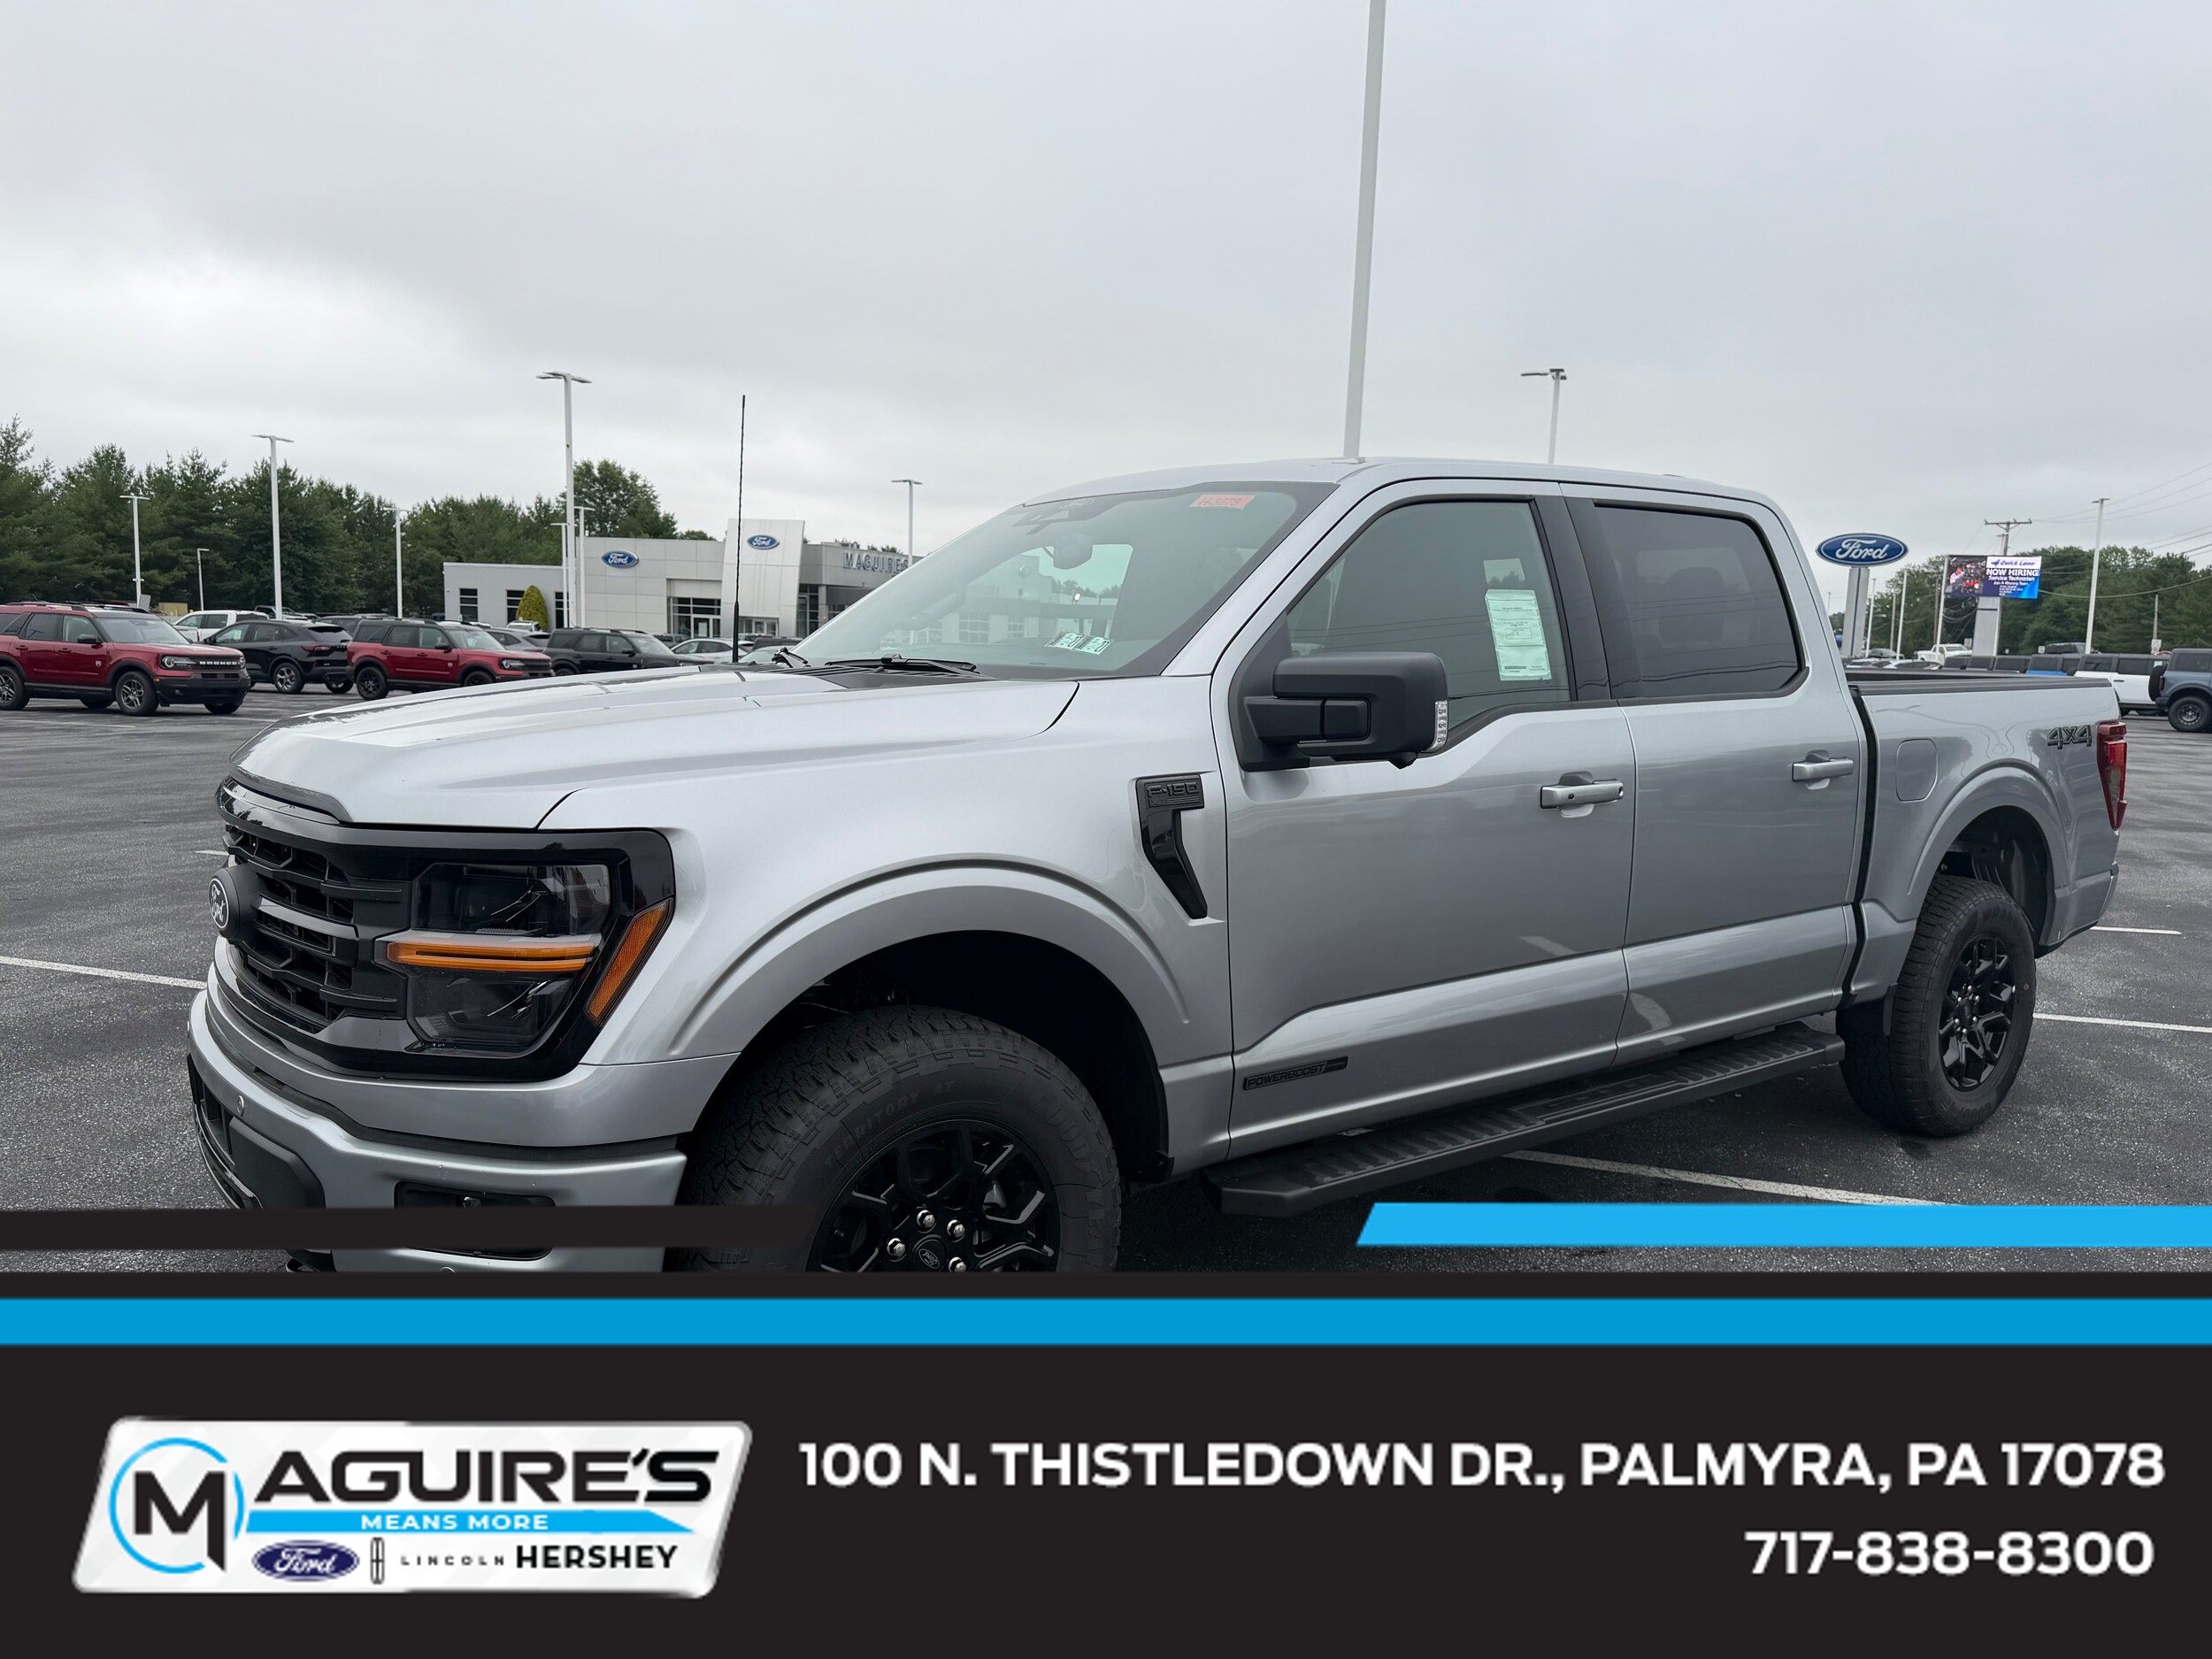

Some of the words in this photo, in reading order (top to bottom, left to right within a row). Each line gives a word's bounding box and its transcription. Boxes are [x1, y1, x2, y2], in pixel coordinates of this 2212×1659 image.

[752, 536, 771, 546] Ford
[1835, 538, 1889, 559] Ford
[608, 552, 629, 565] Ford
[1147, 782, 1200, 797] F-150
[1247, 1064, 1325, 1087] POWERBOOST
[824, 1089, 921, 1169] TERRITORY
